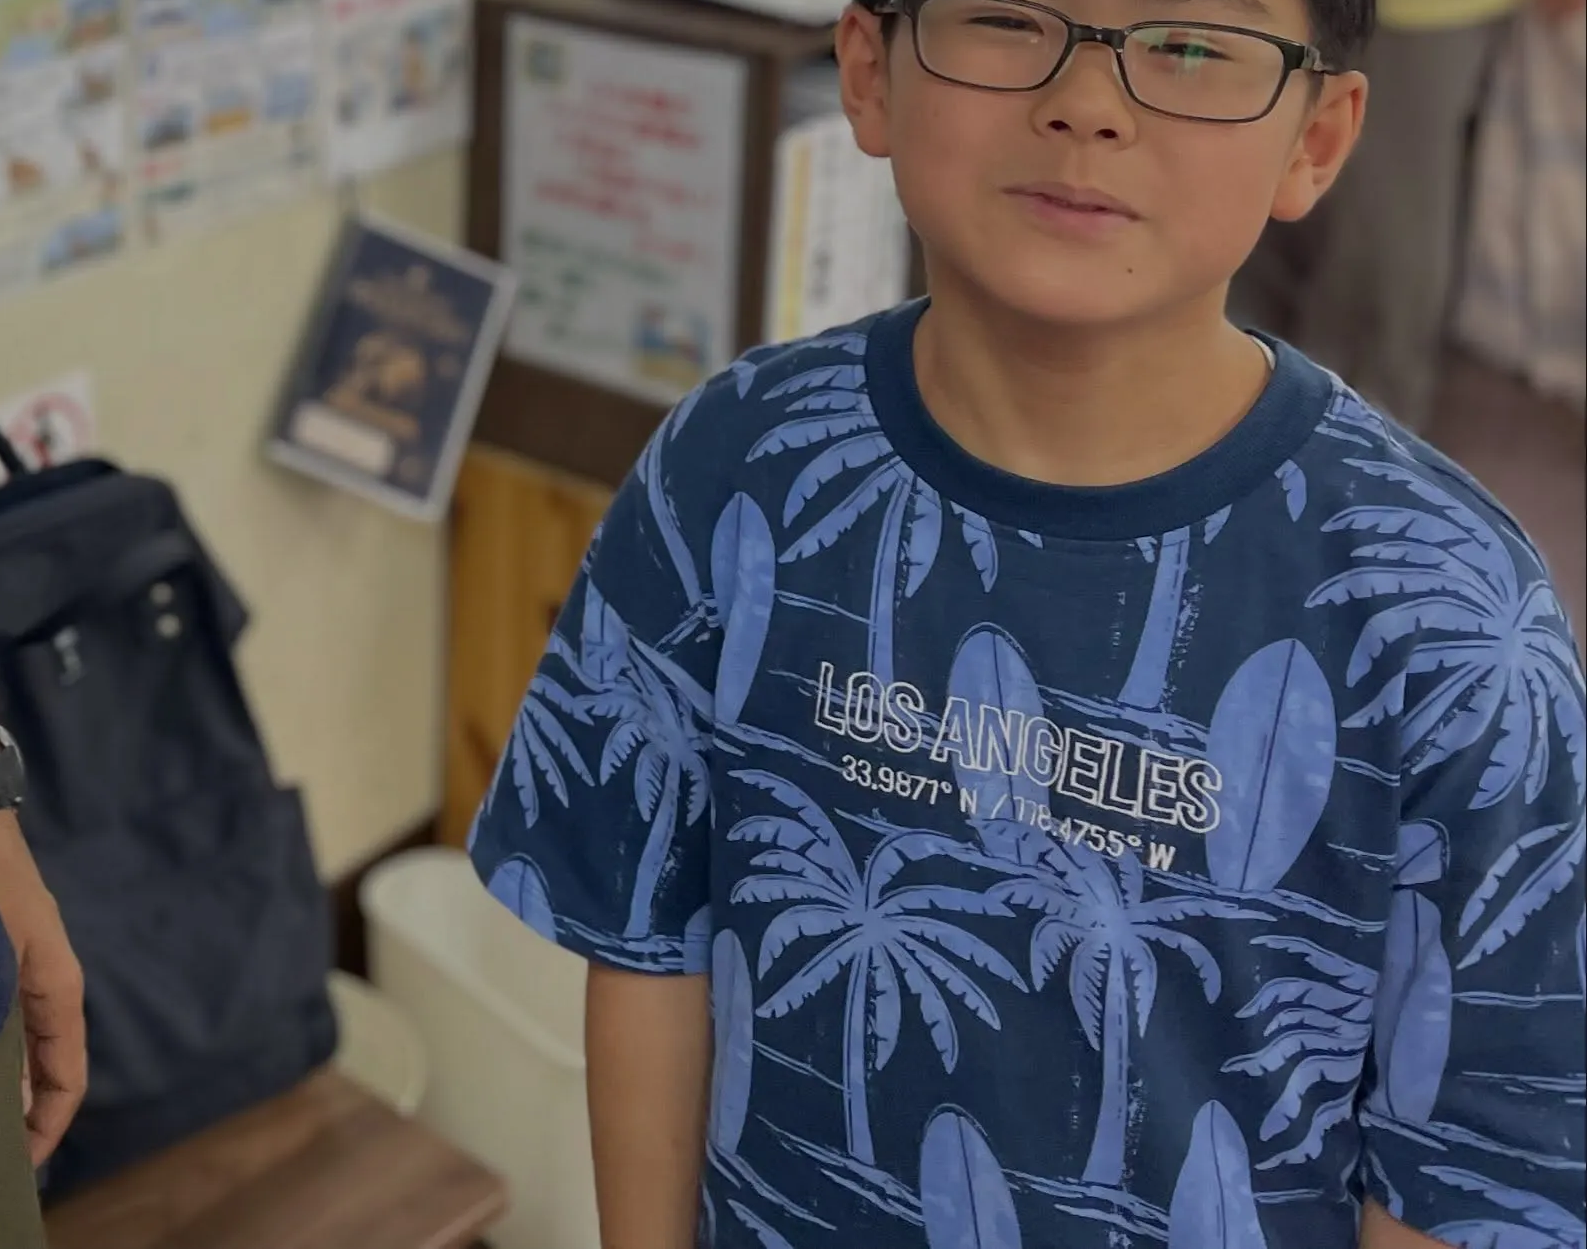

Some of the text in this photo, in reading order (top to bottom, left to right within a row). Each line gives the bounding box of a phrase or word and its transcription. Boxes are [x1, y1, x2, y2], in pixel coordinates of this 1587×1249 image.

[815, 662, 1222, 834] LOS ANGELES
[841, 754, 953, 806] 33.9871°
[959, 787, 978, 815] N
[1148, 841, 1177, 873] W
